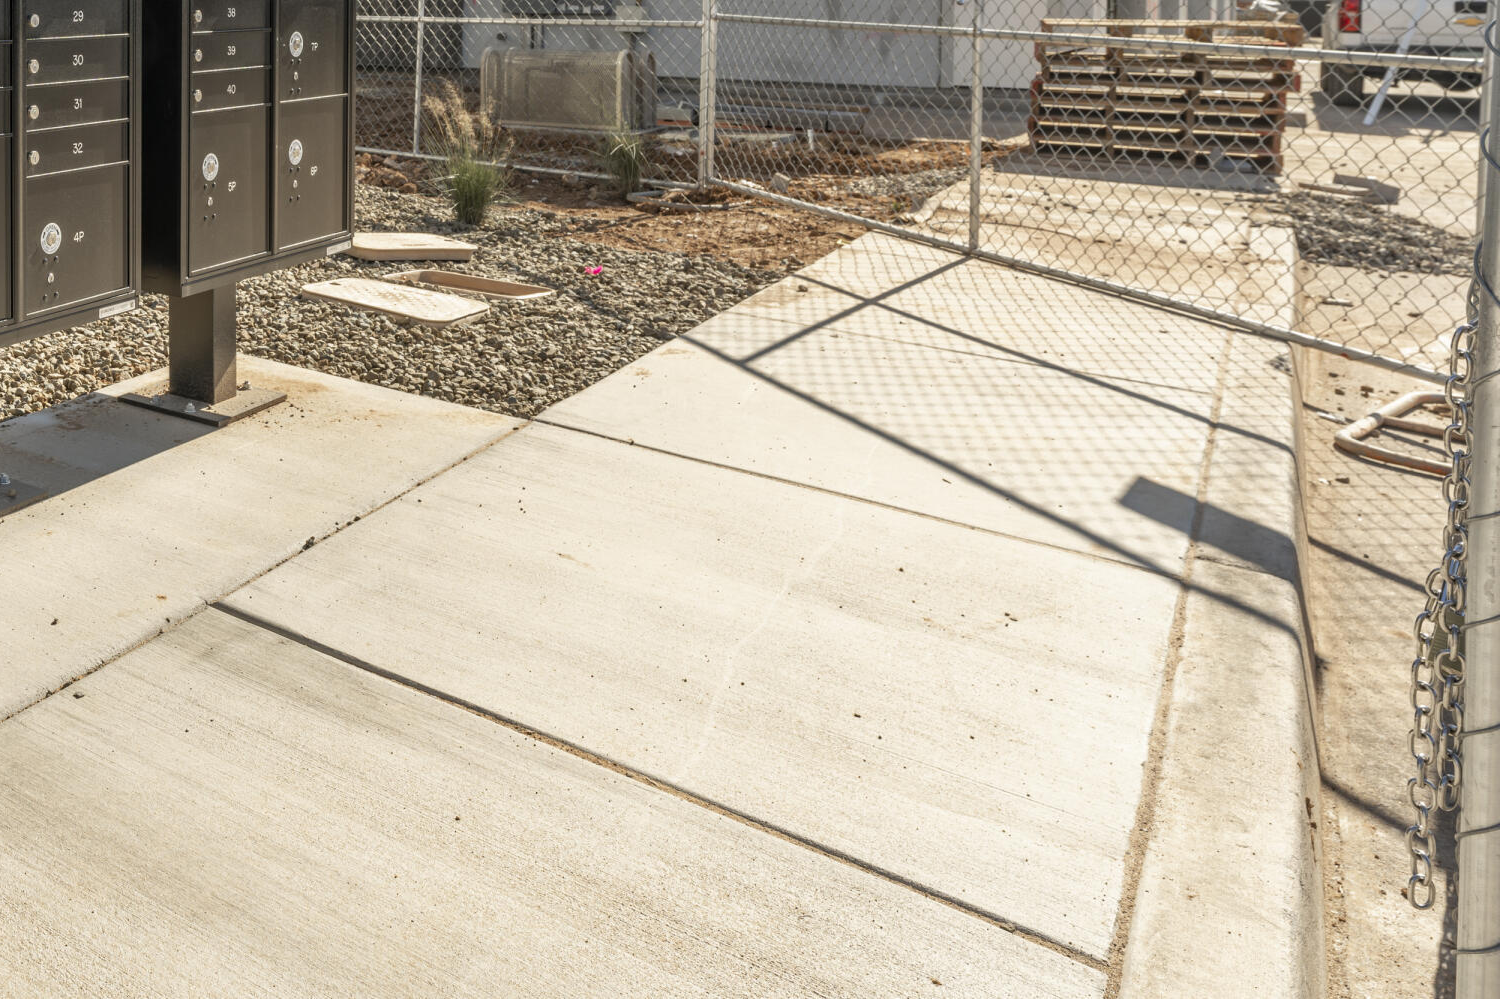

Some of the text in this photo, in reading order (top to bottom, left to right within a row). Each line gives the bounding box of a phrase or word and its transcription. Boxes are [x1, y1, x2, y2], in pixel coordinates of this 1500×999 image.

[72, 10, 84, 23] 29
[227, 7, 236, 18] 38
[227, 45, 237, 56] 39
[72, 54, 84, 67] 30
[226, 84, 237, 95] 40
[73, 98, 83, 110] 31
[72, 142, 84, 155] 32
[73, 230, 85, 243] 4P
